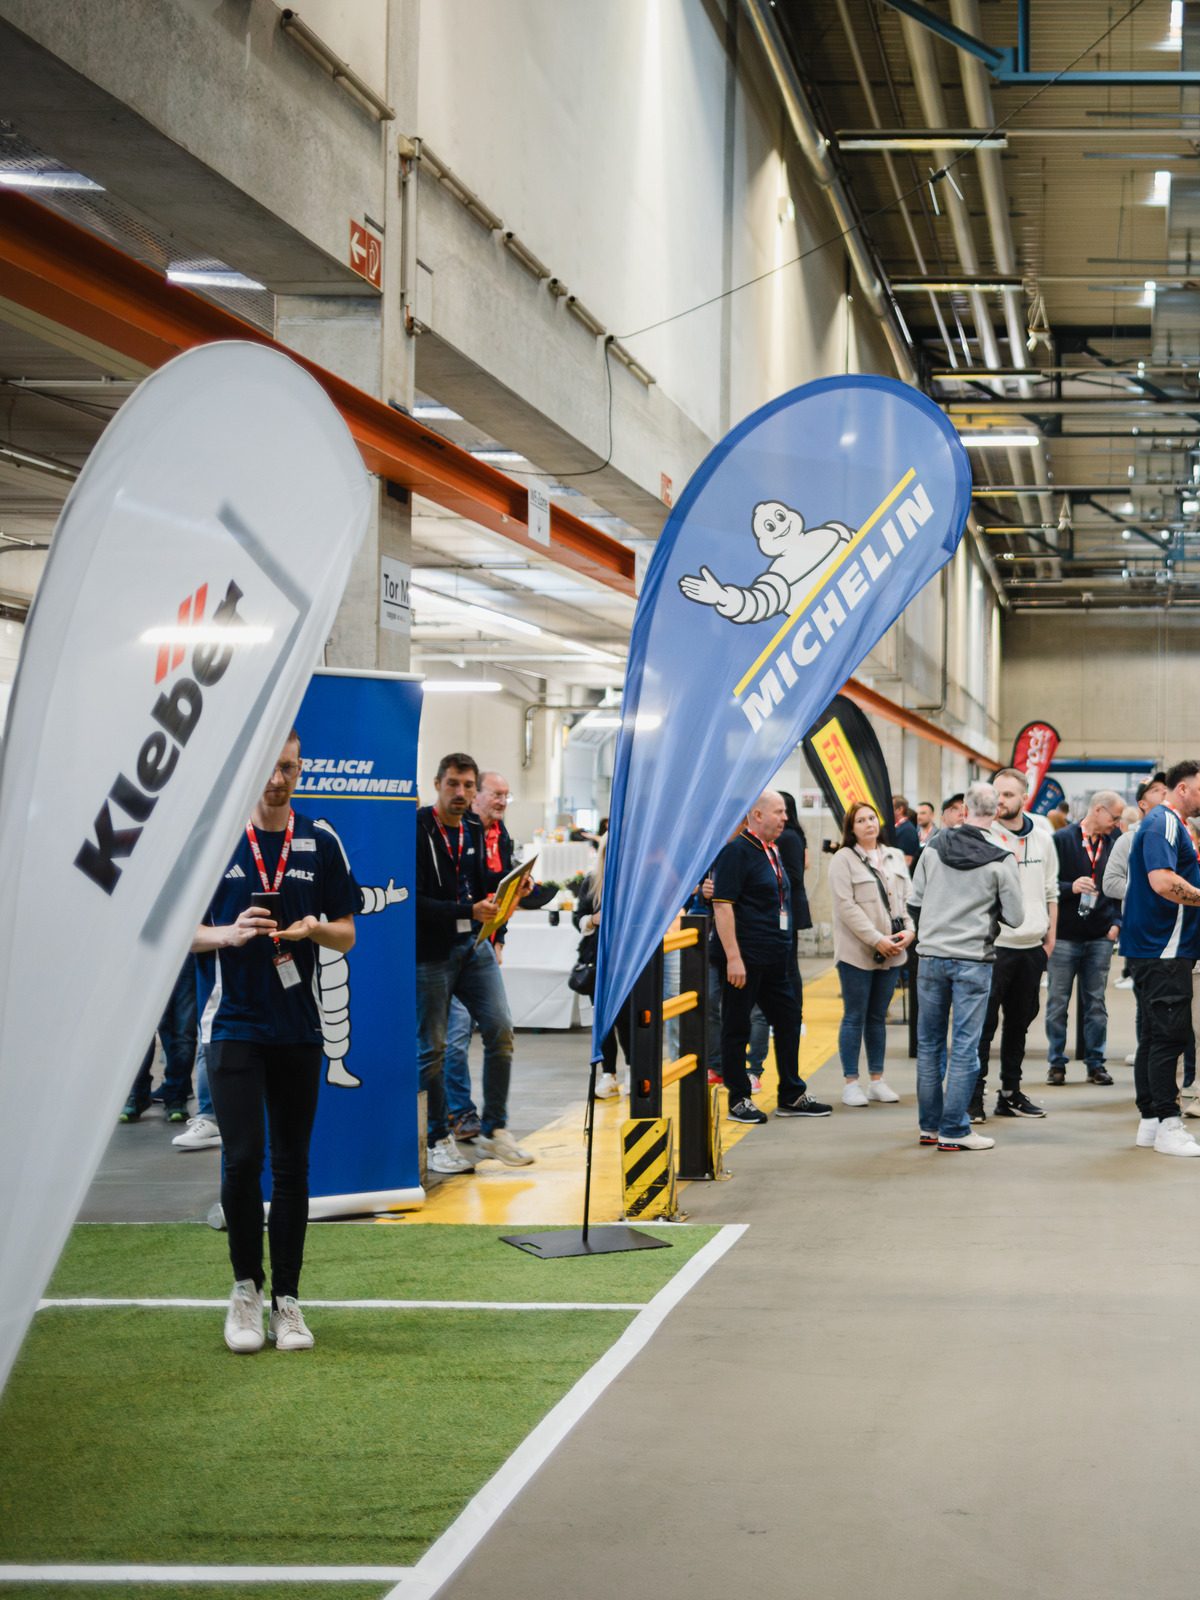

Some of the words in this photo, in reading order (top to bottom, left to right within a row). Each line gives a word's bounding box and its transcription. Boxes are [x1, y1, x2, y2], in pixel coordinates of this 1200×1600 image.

[383, 573, 399, 600] Tor
[741, 483, 934, 734] MICHELIN
[73, 579, 244, 896] Kleber
[300, 758, 374, 775] RZLICH
[295, 777, 413, 793] LLKOMMEN
[285, 868, 315, 882] MLX
